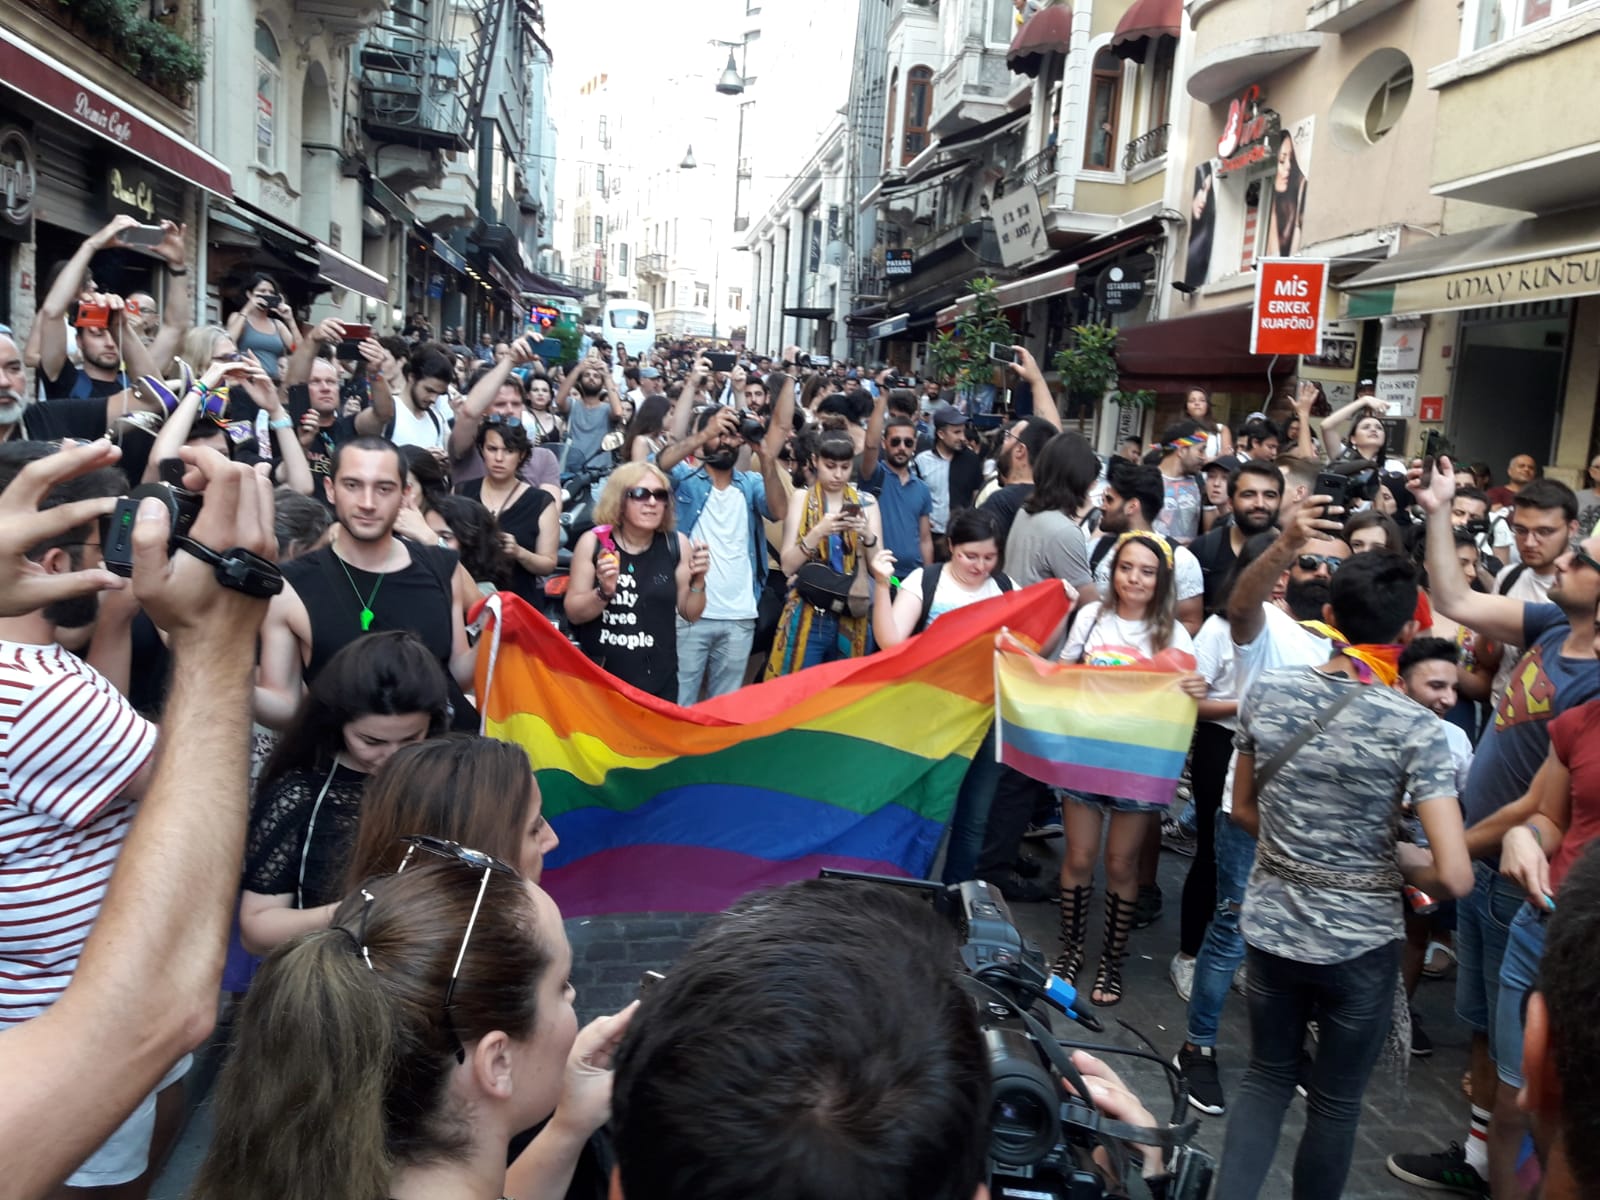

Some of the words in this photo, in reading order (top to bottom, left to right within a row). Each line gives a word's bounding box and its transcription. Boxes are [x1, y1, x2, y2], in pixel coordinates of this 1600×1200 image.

[1274, 274, 1309, 297] MİS
[1446, 272, 1512, 303] UMAY
[1519, 256, 1600, 292] KUNDU
[1268, 300, 1311, 314] ERKEK
[1261, 315, 1315, 330] KUAFÖRÜ
[610, 590, 639, 608] nly
[602, 609, 637, 625] Free
[599, 628, 654, 651] People
